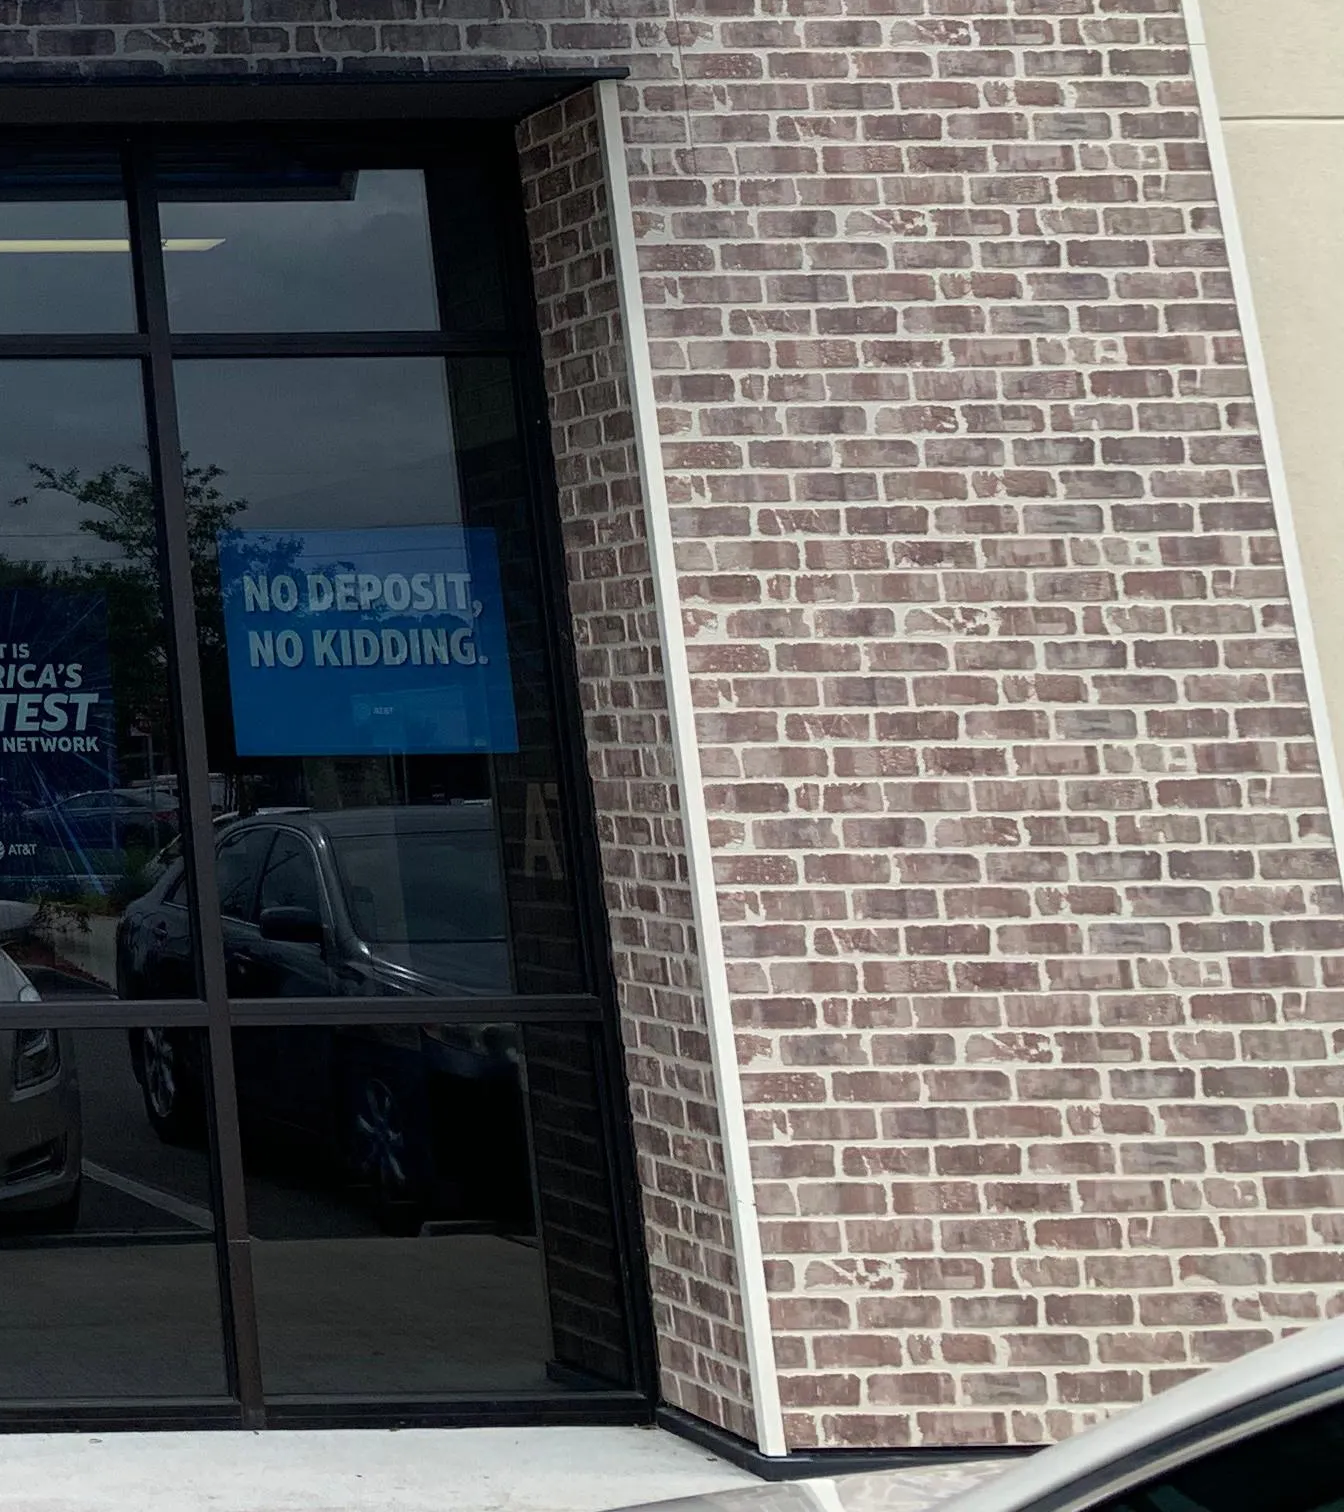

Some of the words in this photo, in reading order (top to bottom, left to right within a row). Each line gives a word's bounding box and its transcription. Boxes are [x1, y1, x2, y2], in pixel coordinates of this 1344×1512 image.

[242, 574, 298, 612] NO
[307, 572, 483, 618] DEPOSIT,
[12, 643, 30, 659] IS
[248, 630, 304, 667] NO
[313, 627, 490, 666] KIDDING.
[3, 736, 100, 753] NETWORK
[8, 843, 38, 856] AT&T
